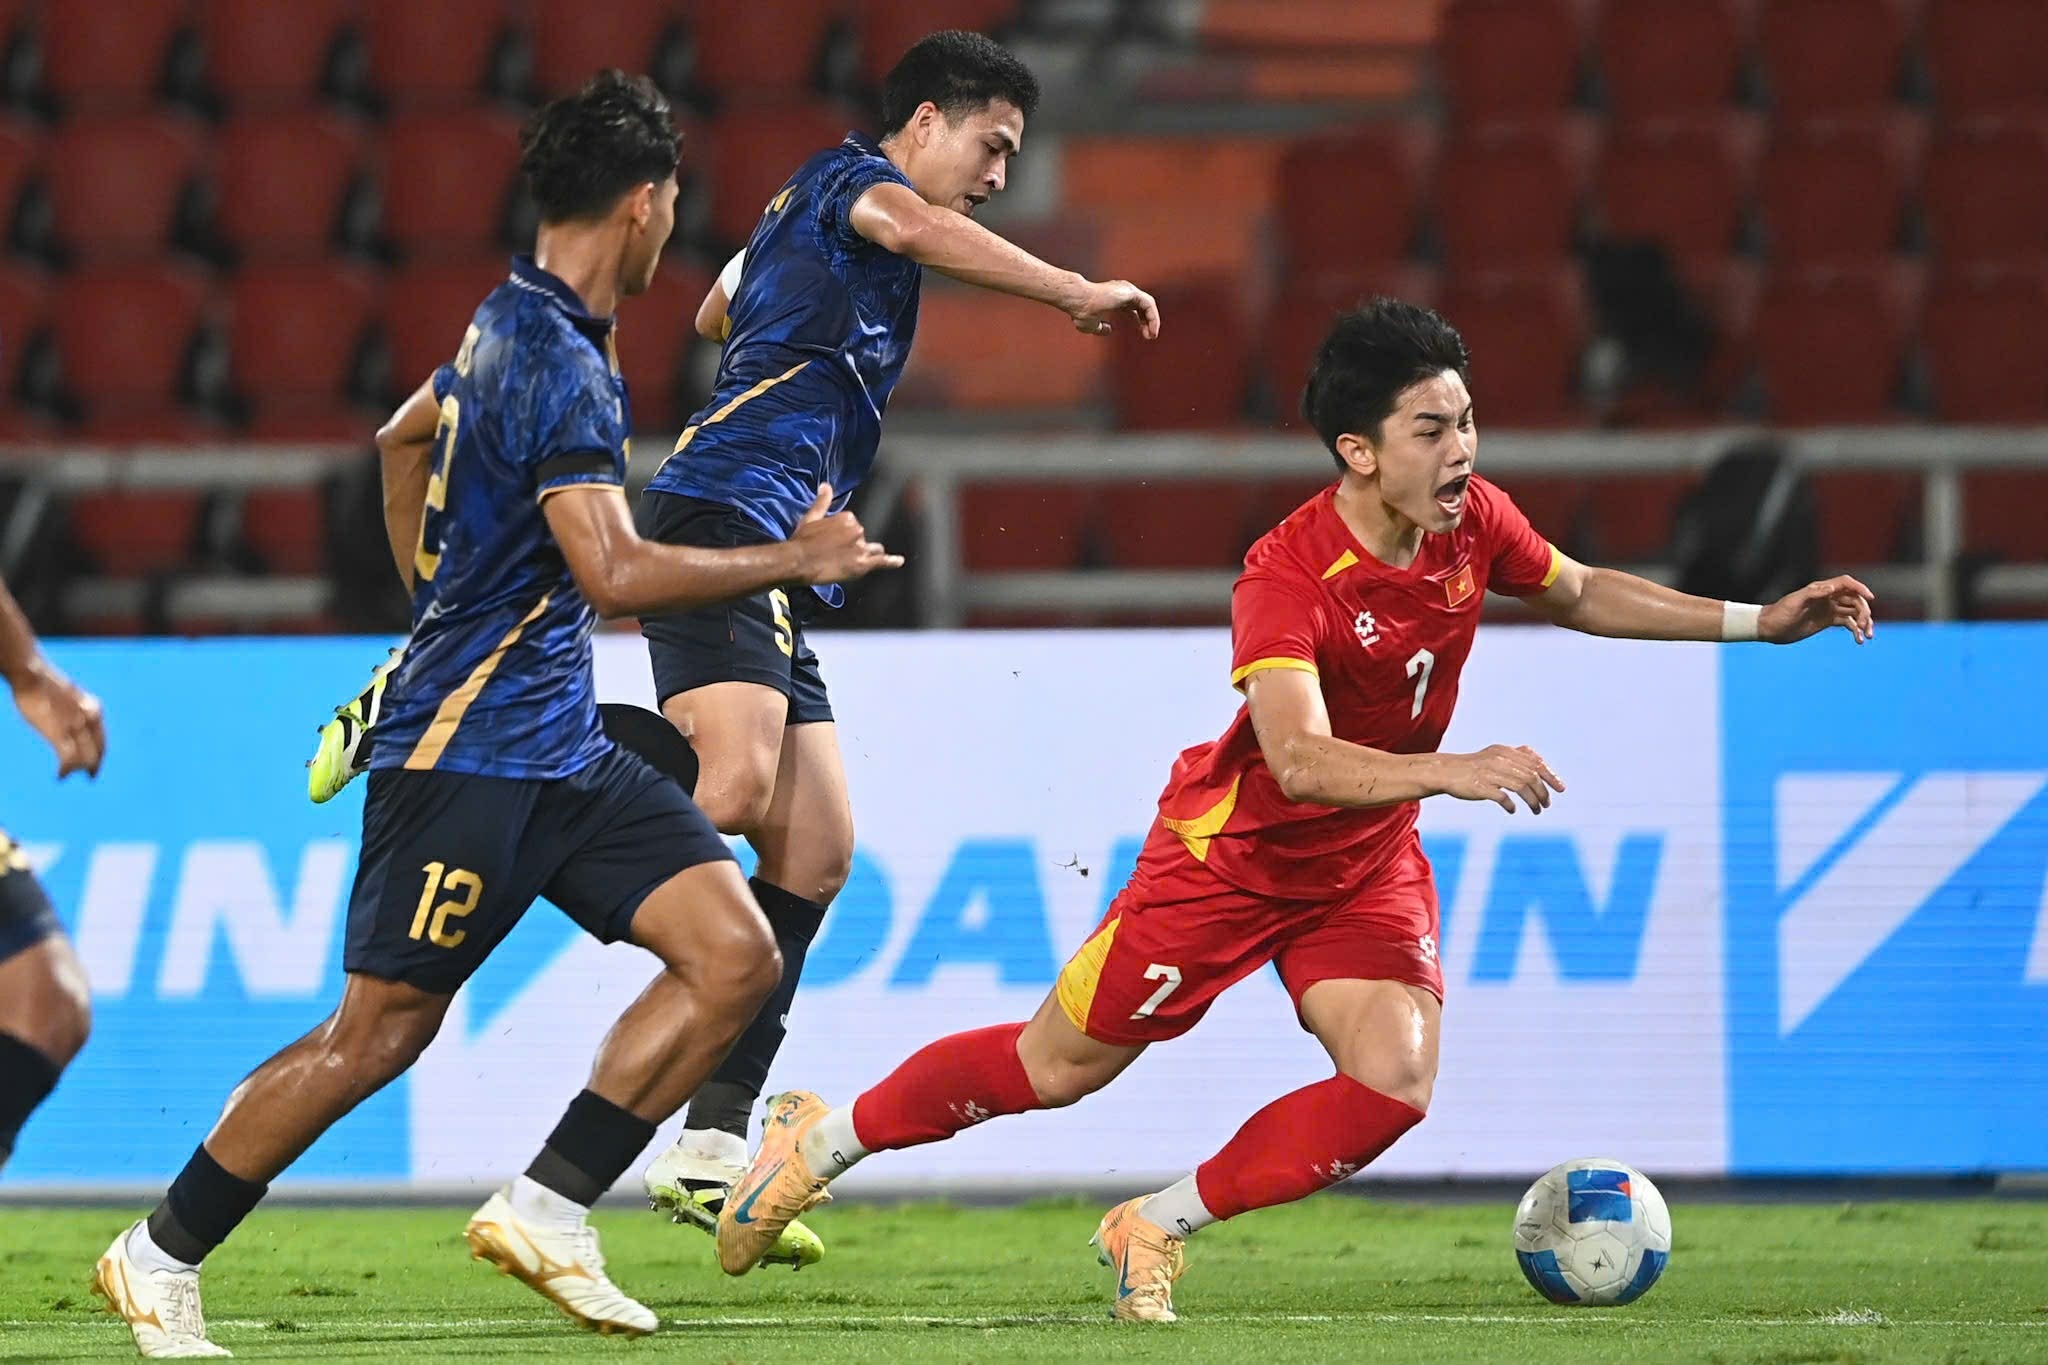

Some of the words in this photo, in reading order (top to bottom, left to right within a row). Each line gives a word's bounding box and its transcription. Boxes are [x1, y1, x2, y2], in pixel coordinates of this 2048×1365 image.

[768, 588, 794, 658] 5
[1405, 647, 1435, 720] 7
[26, 840, 350, 998] IN
[408, 861, 483, 948] 12
[1128, 962, 1183, 1020] 7
